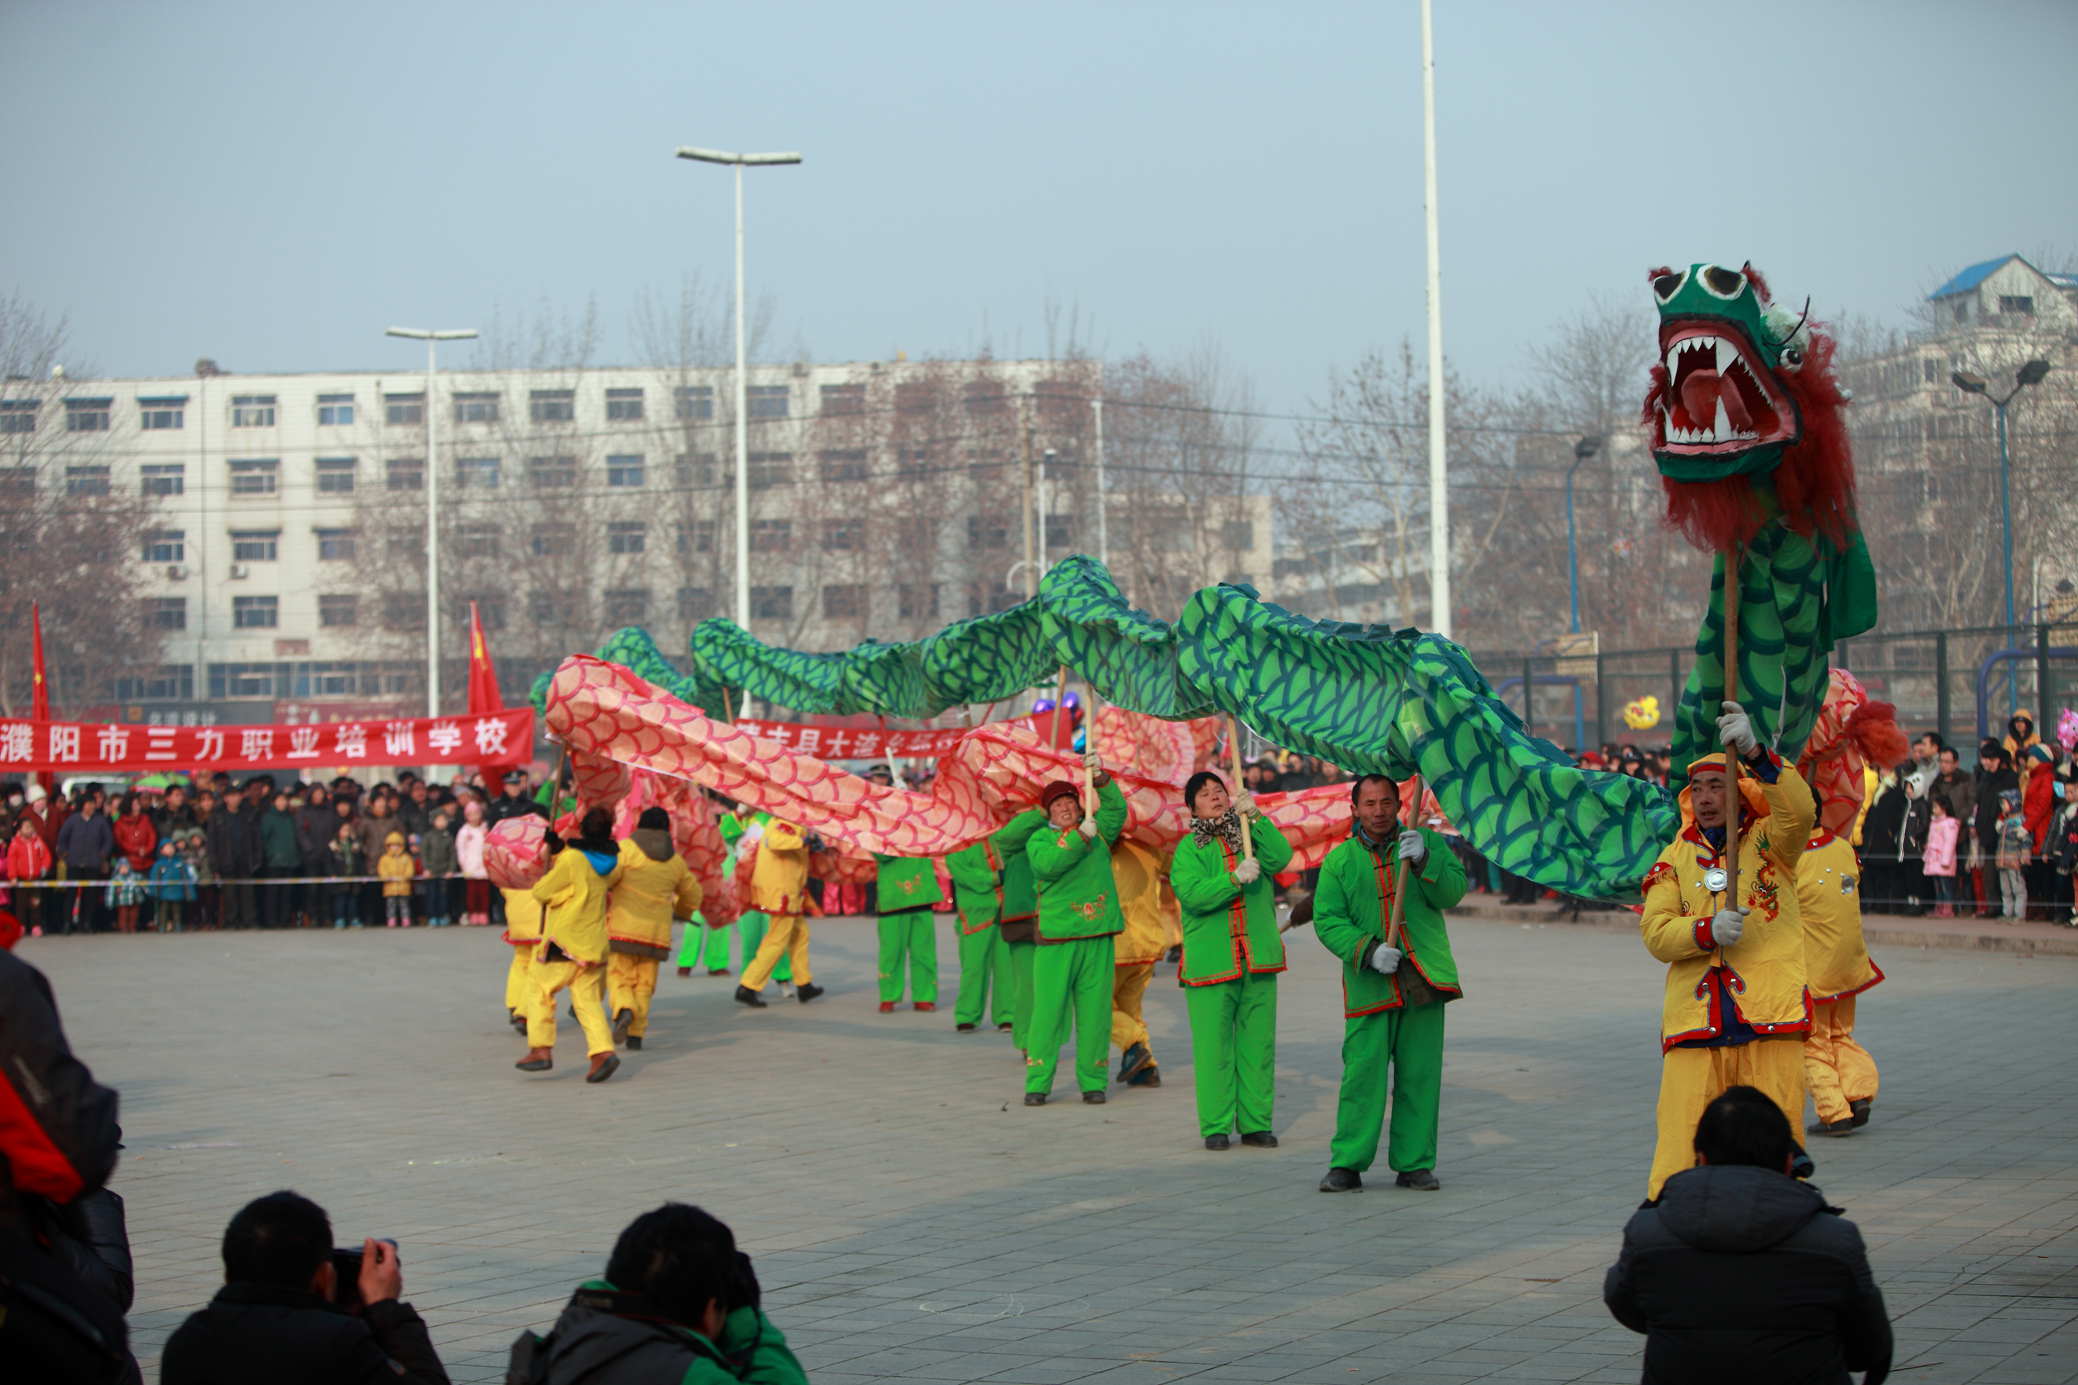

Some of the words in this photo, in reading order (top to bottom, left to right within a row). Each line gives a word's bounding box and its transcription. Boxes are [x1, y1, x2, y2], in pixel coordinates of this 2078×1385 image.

[0, 717, 508, 763] 濮阳市三力职业培训学校
